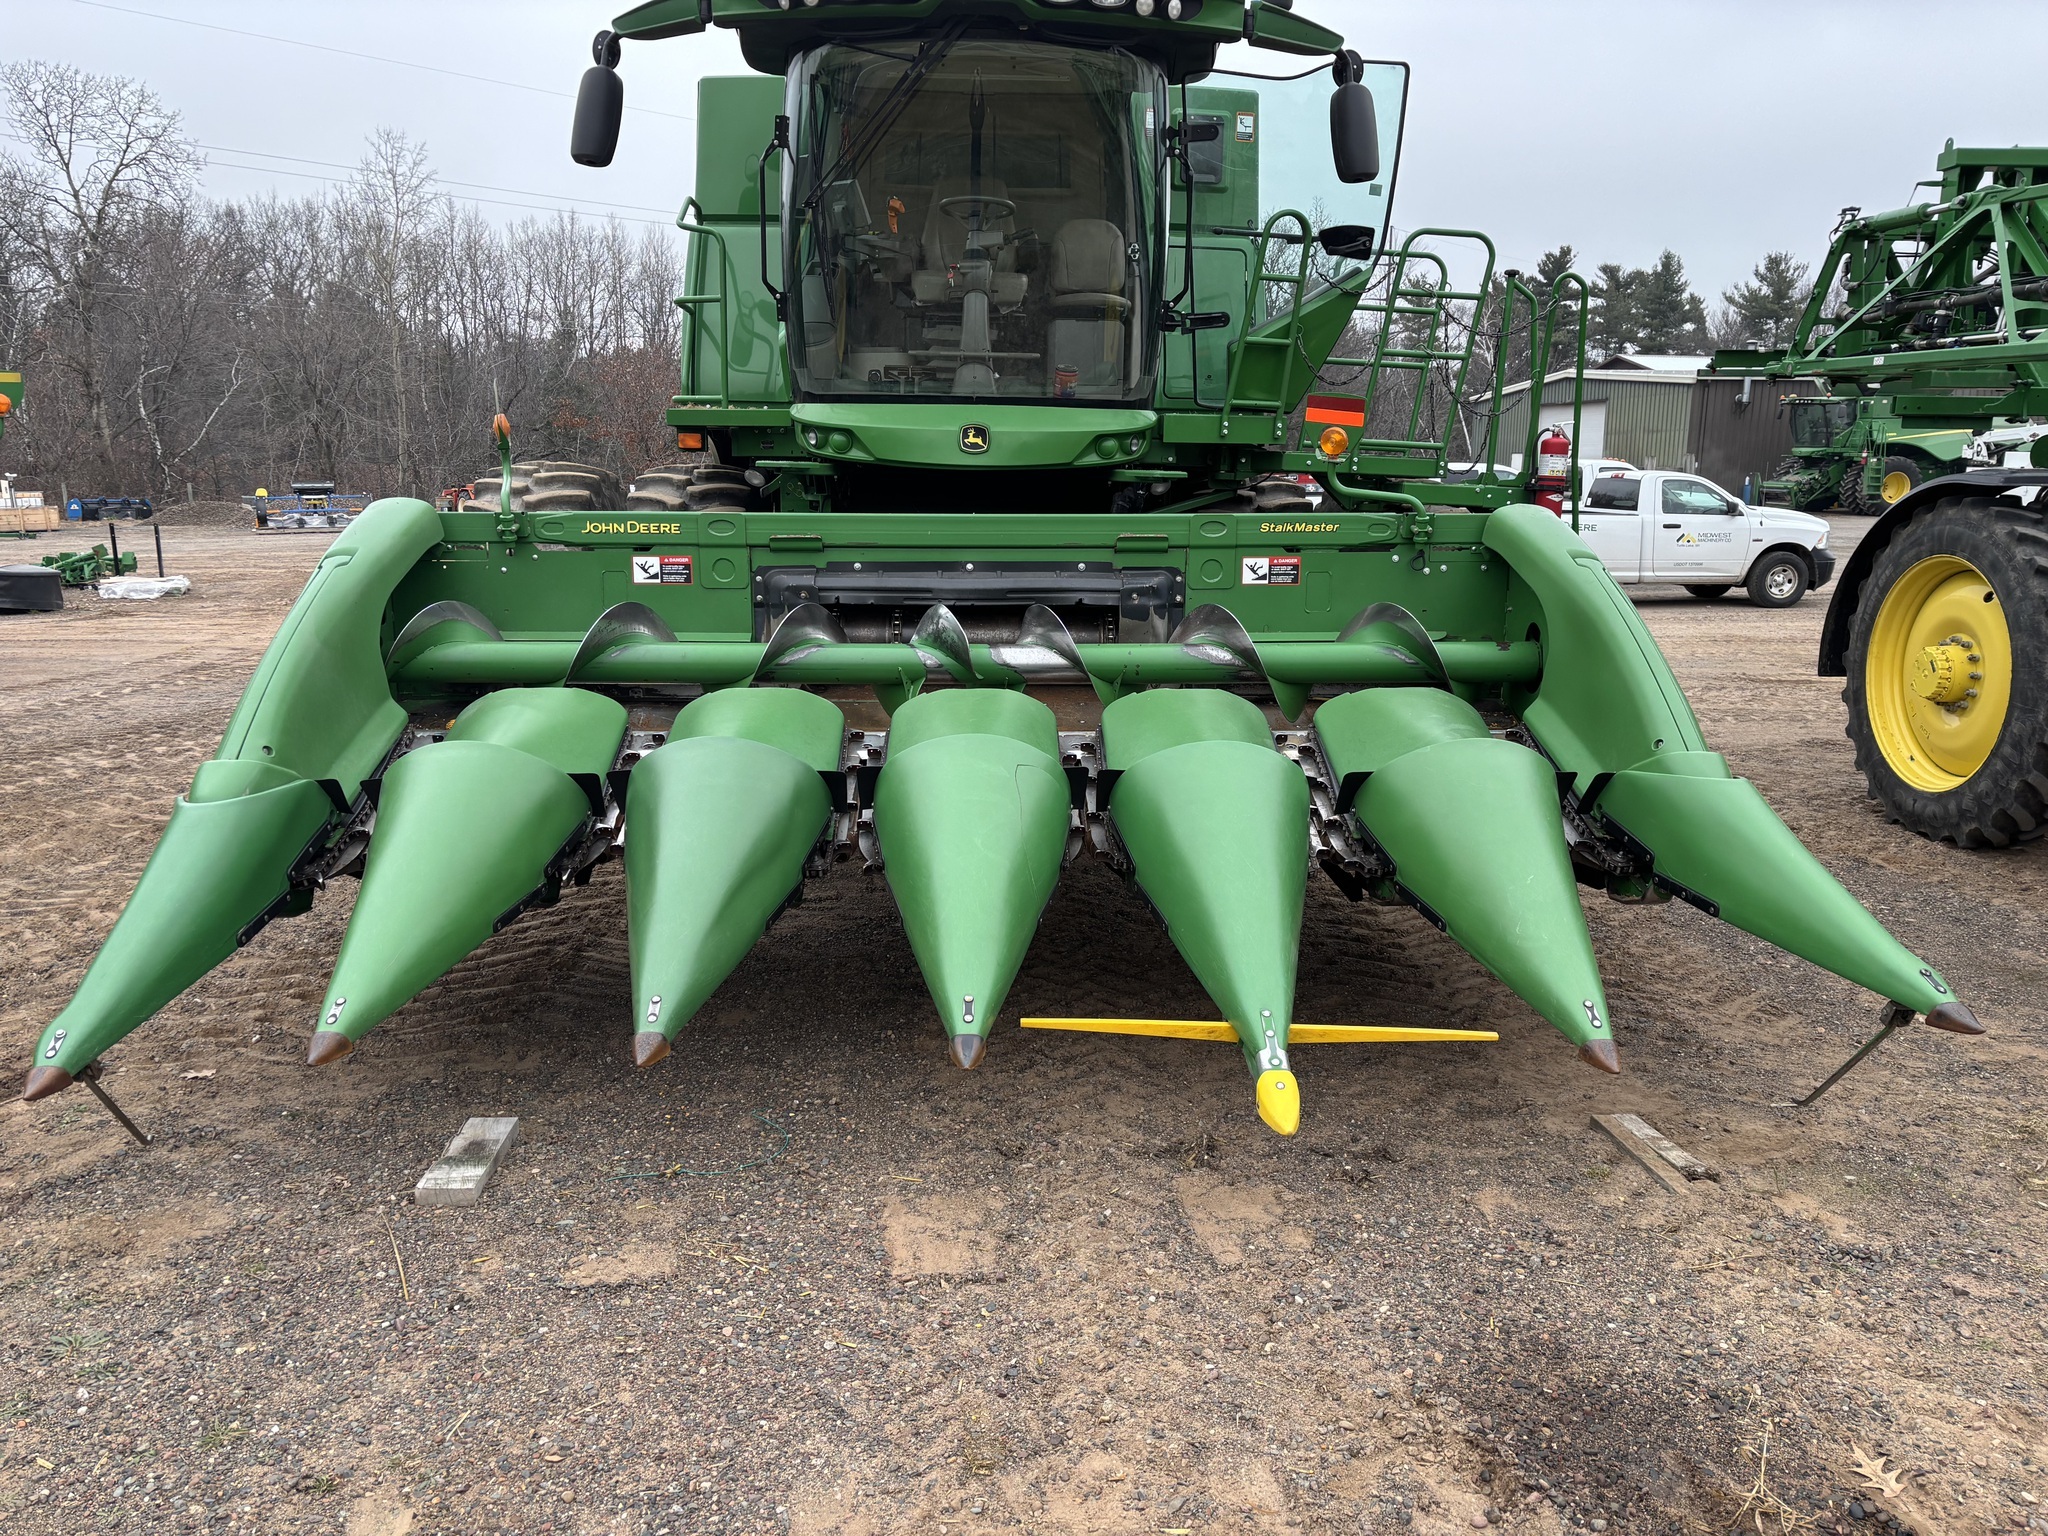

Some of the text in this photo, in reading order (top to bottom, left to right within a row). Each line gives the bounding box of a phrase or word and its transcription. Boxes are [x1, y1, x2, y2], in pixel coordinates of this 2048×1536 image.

[581, 521, 681, 534] JOHN DEERE
[1260, 522, 1340, 533] StalkMaster
